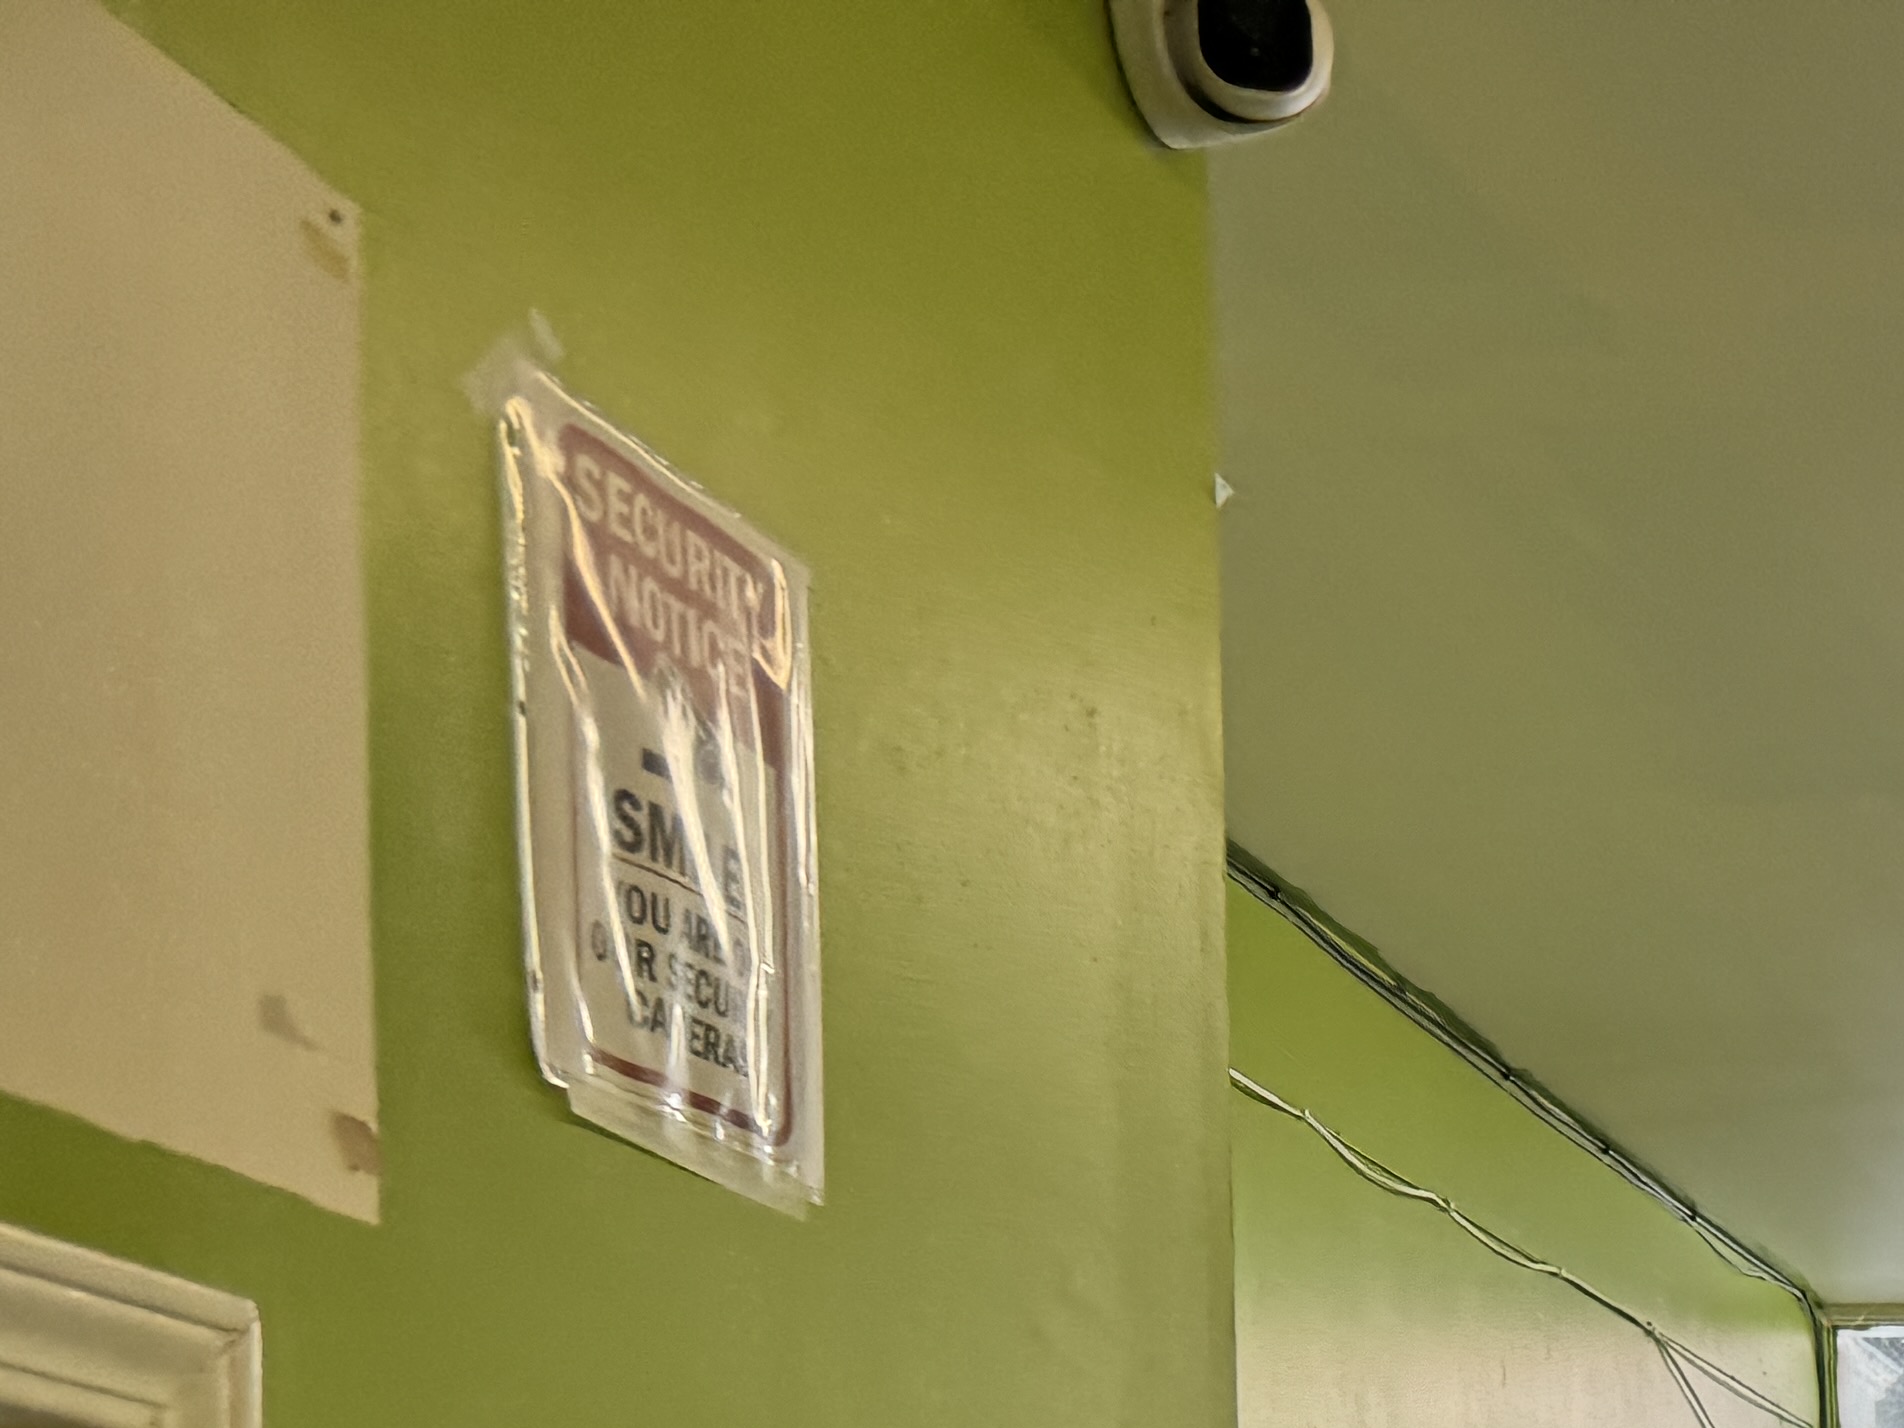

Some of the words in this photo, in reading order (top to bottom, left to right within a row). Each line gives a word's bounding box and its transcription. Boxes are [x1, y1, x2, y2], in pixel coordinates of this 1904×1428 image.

[573, 454, 763, 621] SECURITY
[609, 553, 750, 697] NOTICE
[612, 787, 742, 912] SME
[612, 879, 671, 936] OU
[591, 918, 657, 983] OR
